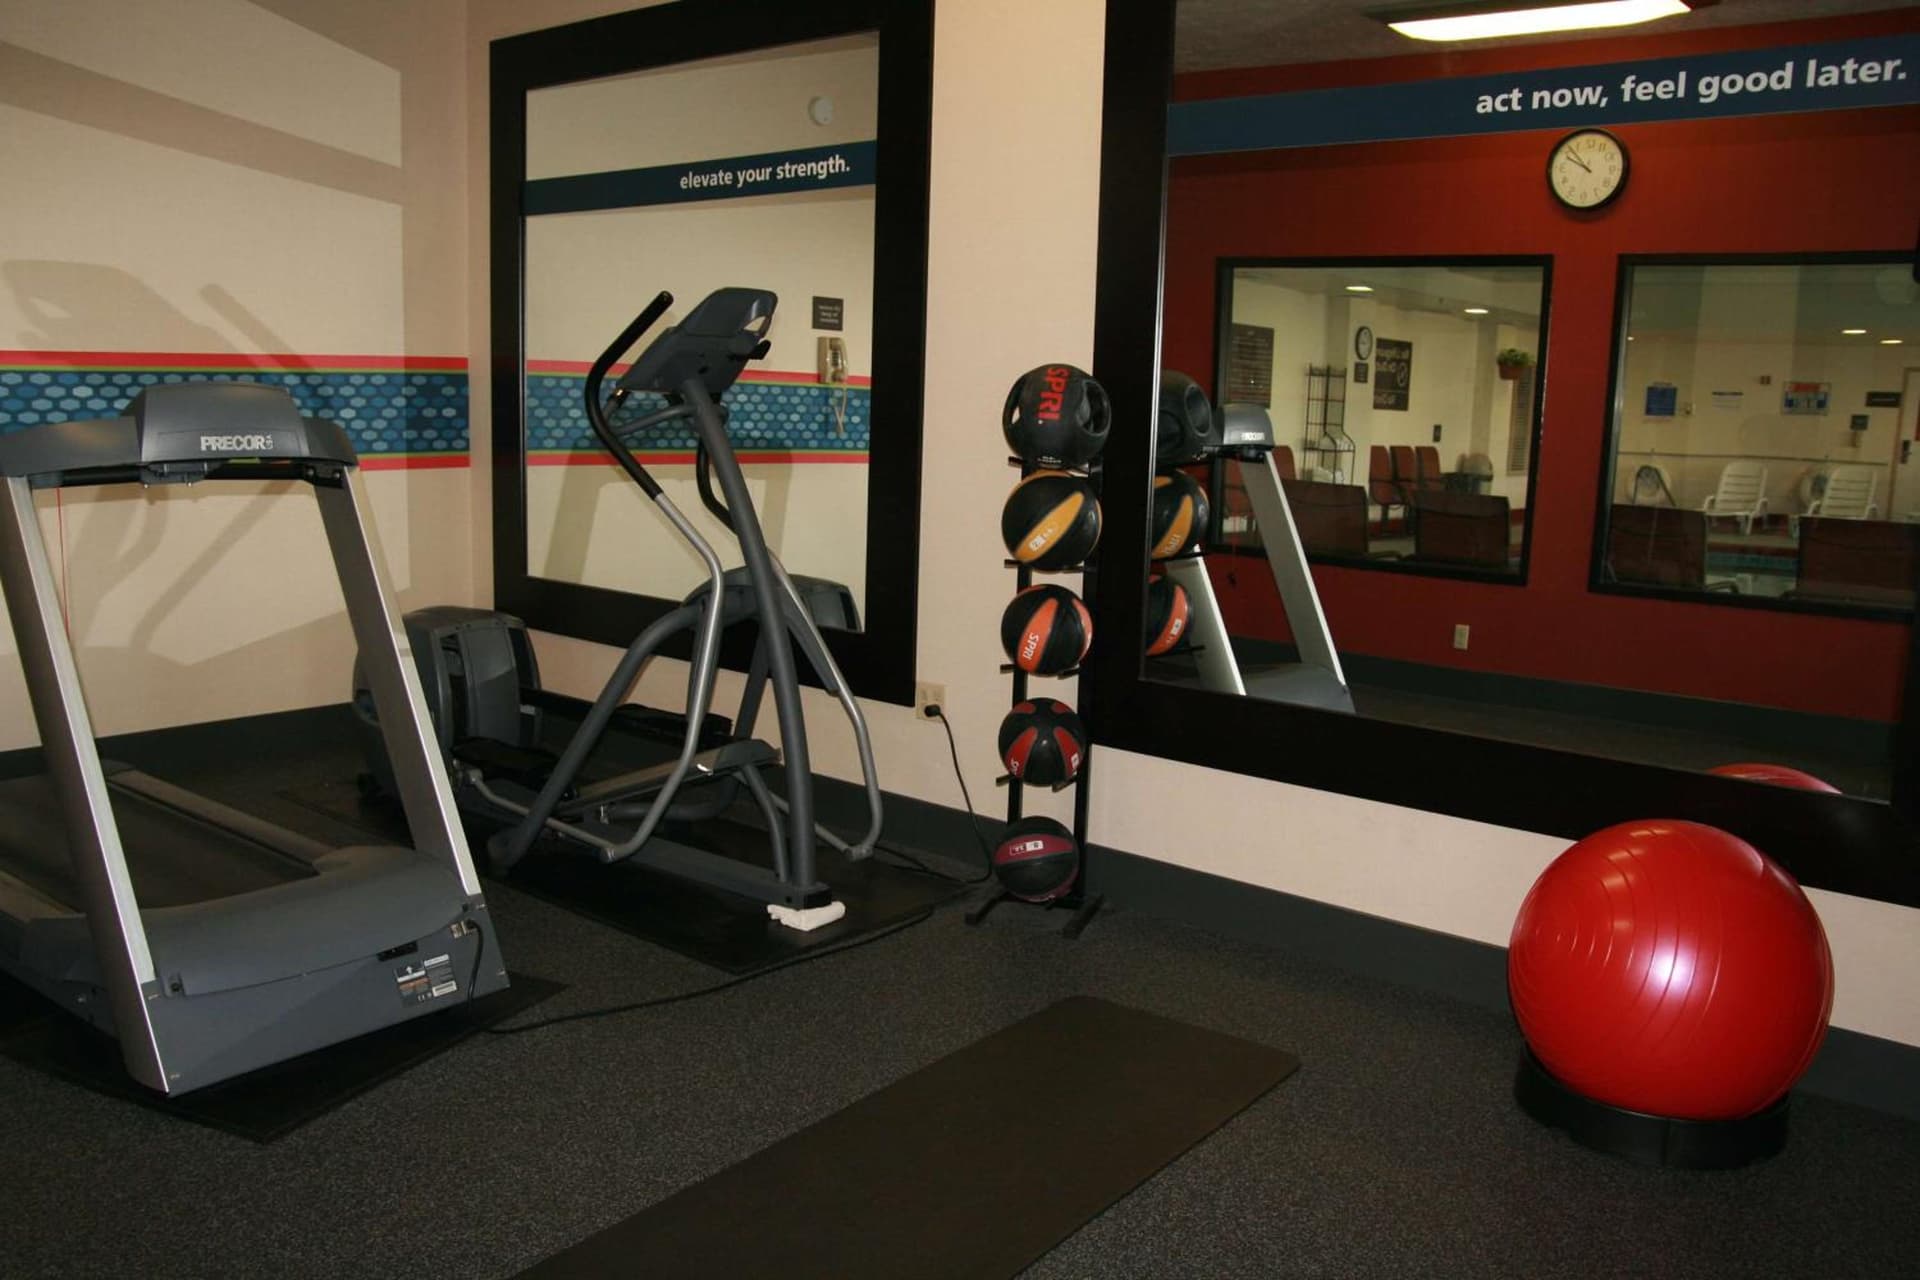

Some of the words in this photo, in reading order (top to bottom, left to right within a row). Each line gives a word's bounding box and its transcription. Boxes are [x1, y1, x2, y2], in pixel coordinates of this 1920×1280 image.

[1475, 87, 1523, 114] act
[1531, 84, 1609, 109] now,
[1620, 71, 1687, 103] feel
[1697, 61, 1794, 104] good
[1805, 58, 1907, 88] later.
[679, 170, 733, 190] elevate
[736, 166, 773, 189] your
[776, 153, 851, 180] strength.
[1036, 367, 1070, 421] SPRI
[200, 434, 266, 451] PRECOR
[1022, 632, 1040, 661] SPRI
